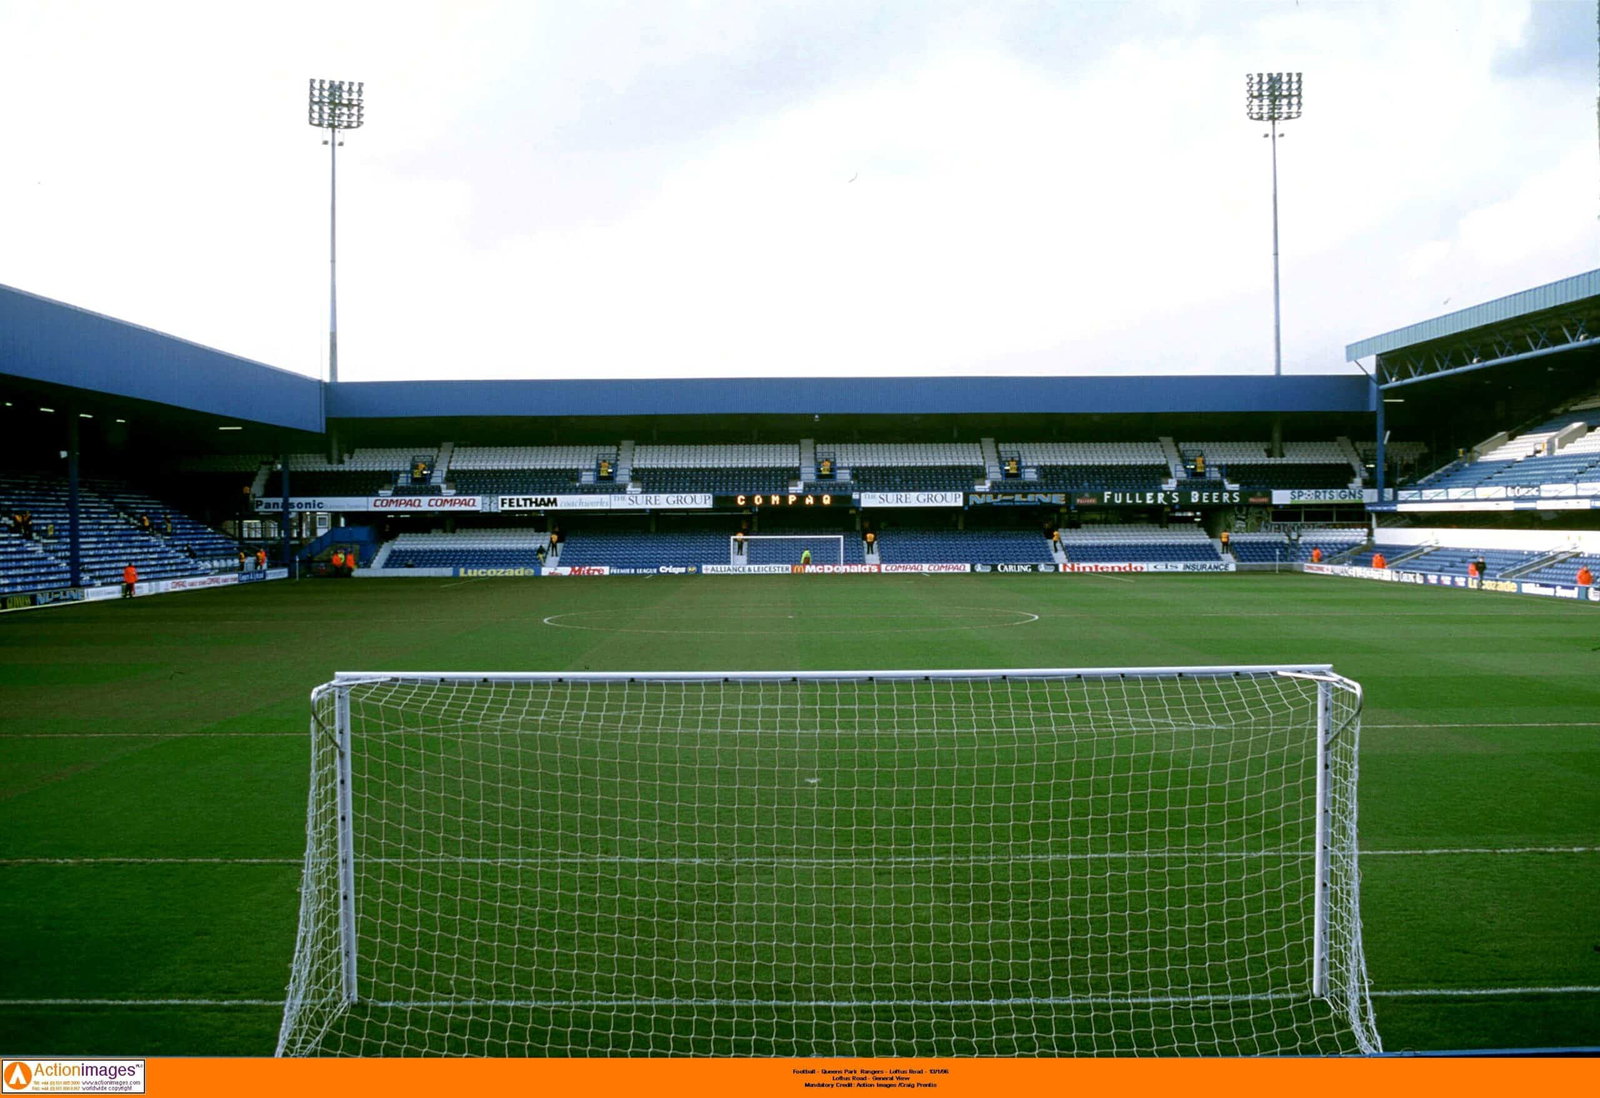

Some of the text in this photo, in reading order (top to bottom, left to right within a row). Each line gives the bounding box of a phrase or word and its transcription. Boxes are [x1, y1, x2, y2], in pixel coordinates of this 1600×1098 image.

[373, 498, 423, 508] COMPAQ
[427, 498, 477, 508] COMPAQ
[500, 498, 558, 508] FELTHAM
[628, 495, 660, 505] SURE
[665, 494, 711, 505] GROUP
[737, 494, 831, 506] COMPAQ
[878, 493, 912, 504] SURE
[916, 493, 961, 504] GROUP
[1103, 491, 1180, 505] FULLER'S
[1191, 491, 1240, 503] BEERS
[459, 567, 535, 577] Lucozade
[568, 566, 605, 576] Mitre
[805, 564, 879, 573] McDonald's
[997, 563, 1032, 573] CARLING
[1062, 563, 1145, 573] Nintendo
[1182, 563, 1230, 571] INSURANCE
